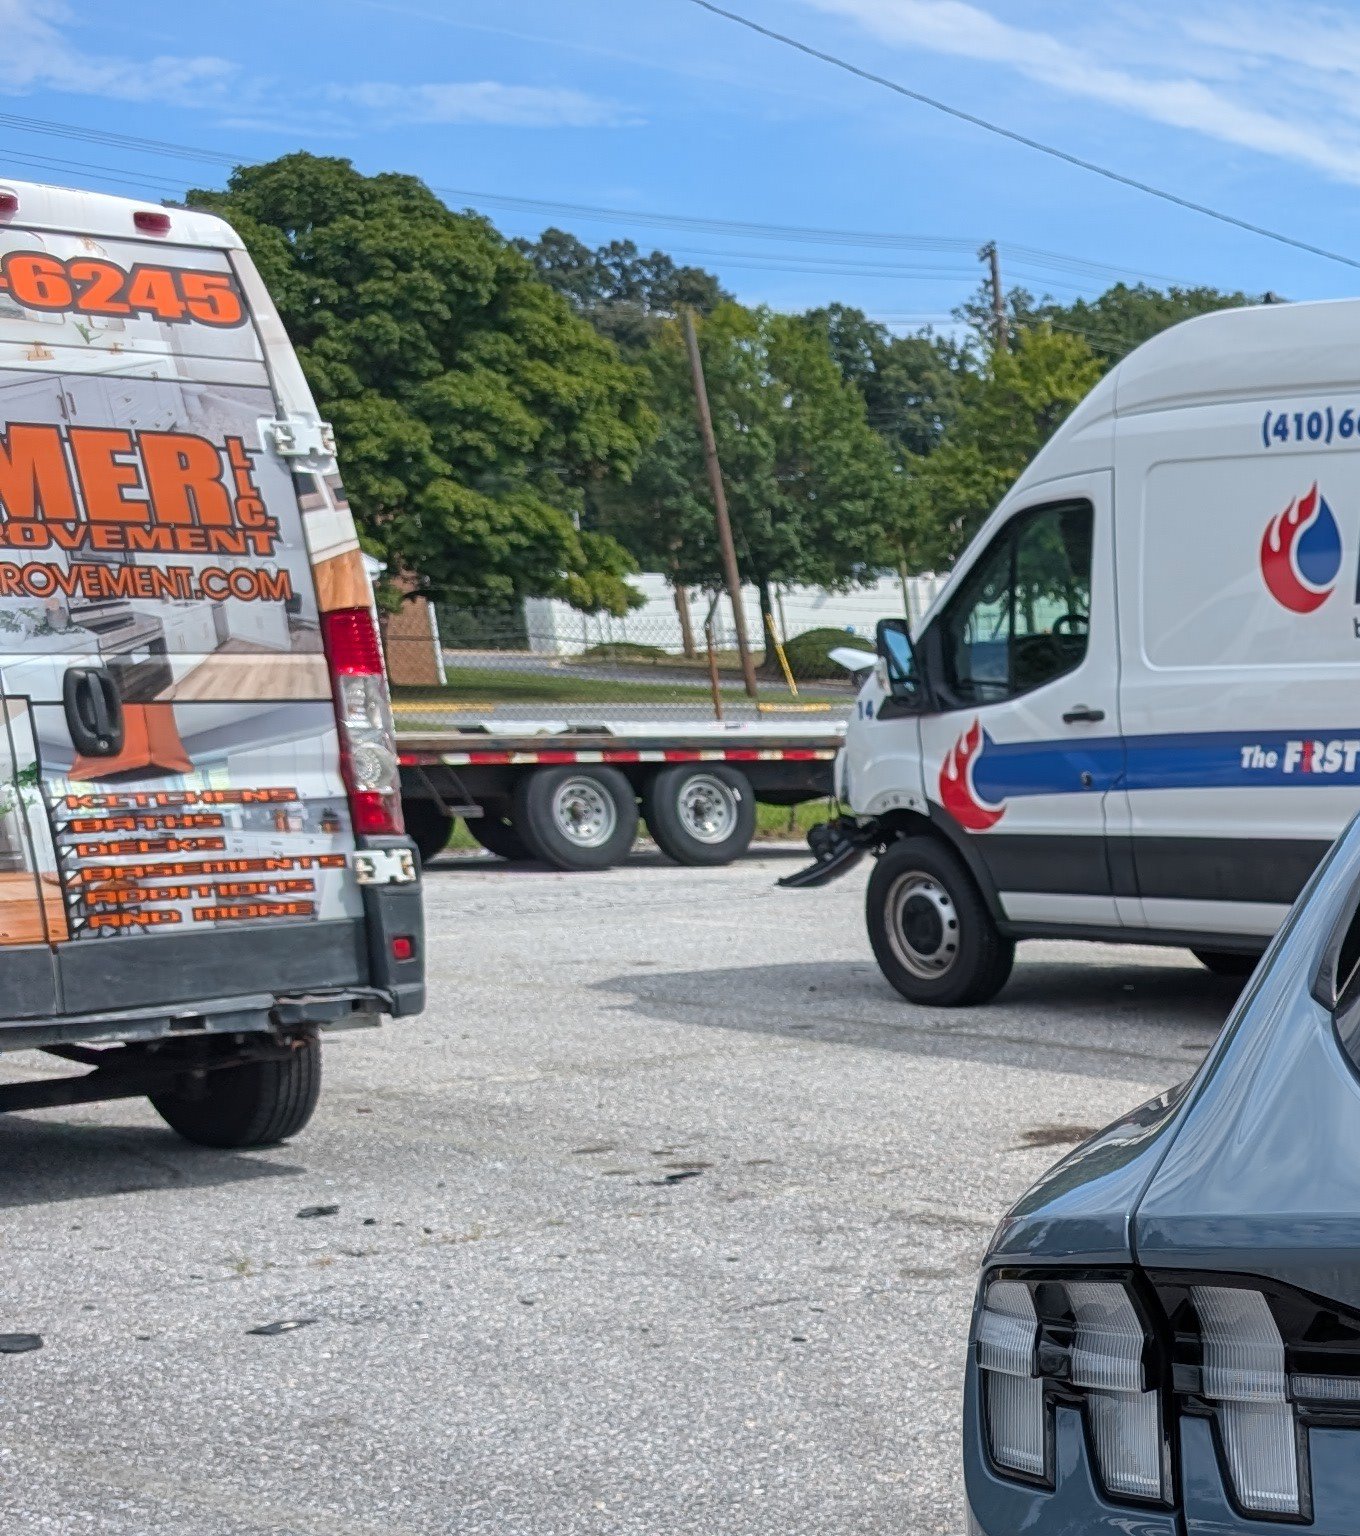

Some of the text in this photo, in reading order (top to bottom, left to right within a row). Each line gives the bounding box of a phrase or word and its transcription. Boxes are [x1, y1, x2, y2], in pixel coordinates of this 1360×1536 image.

[0, 521, 283, 556] OVEMENT
[1240, 744, 1278, 769] The
[66, 785, 299, 810] KITCHENS
[70, 813, 224, 834] BATHS
[76, 836, 227, 857] DECKS
[81, 853, 348, 882] BASEMENTS
[85, 878, 316, 906] ADDITIONS
[88, 900, 316, 930] AND MORE
